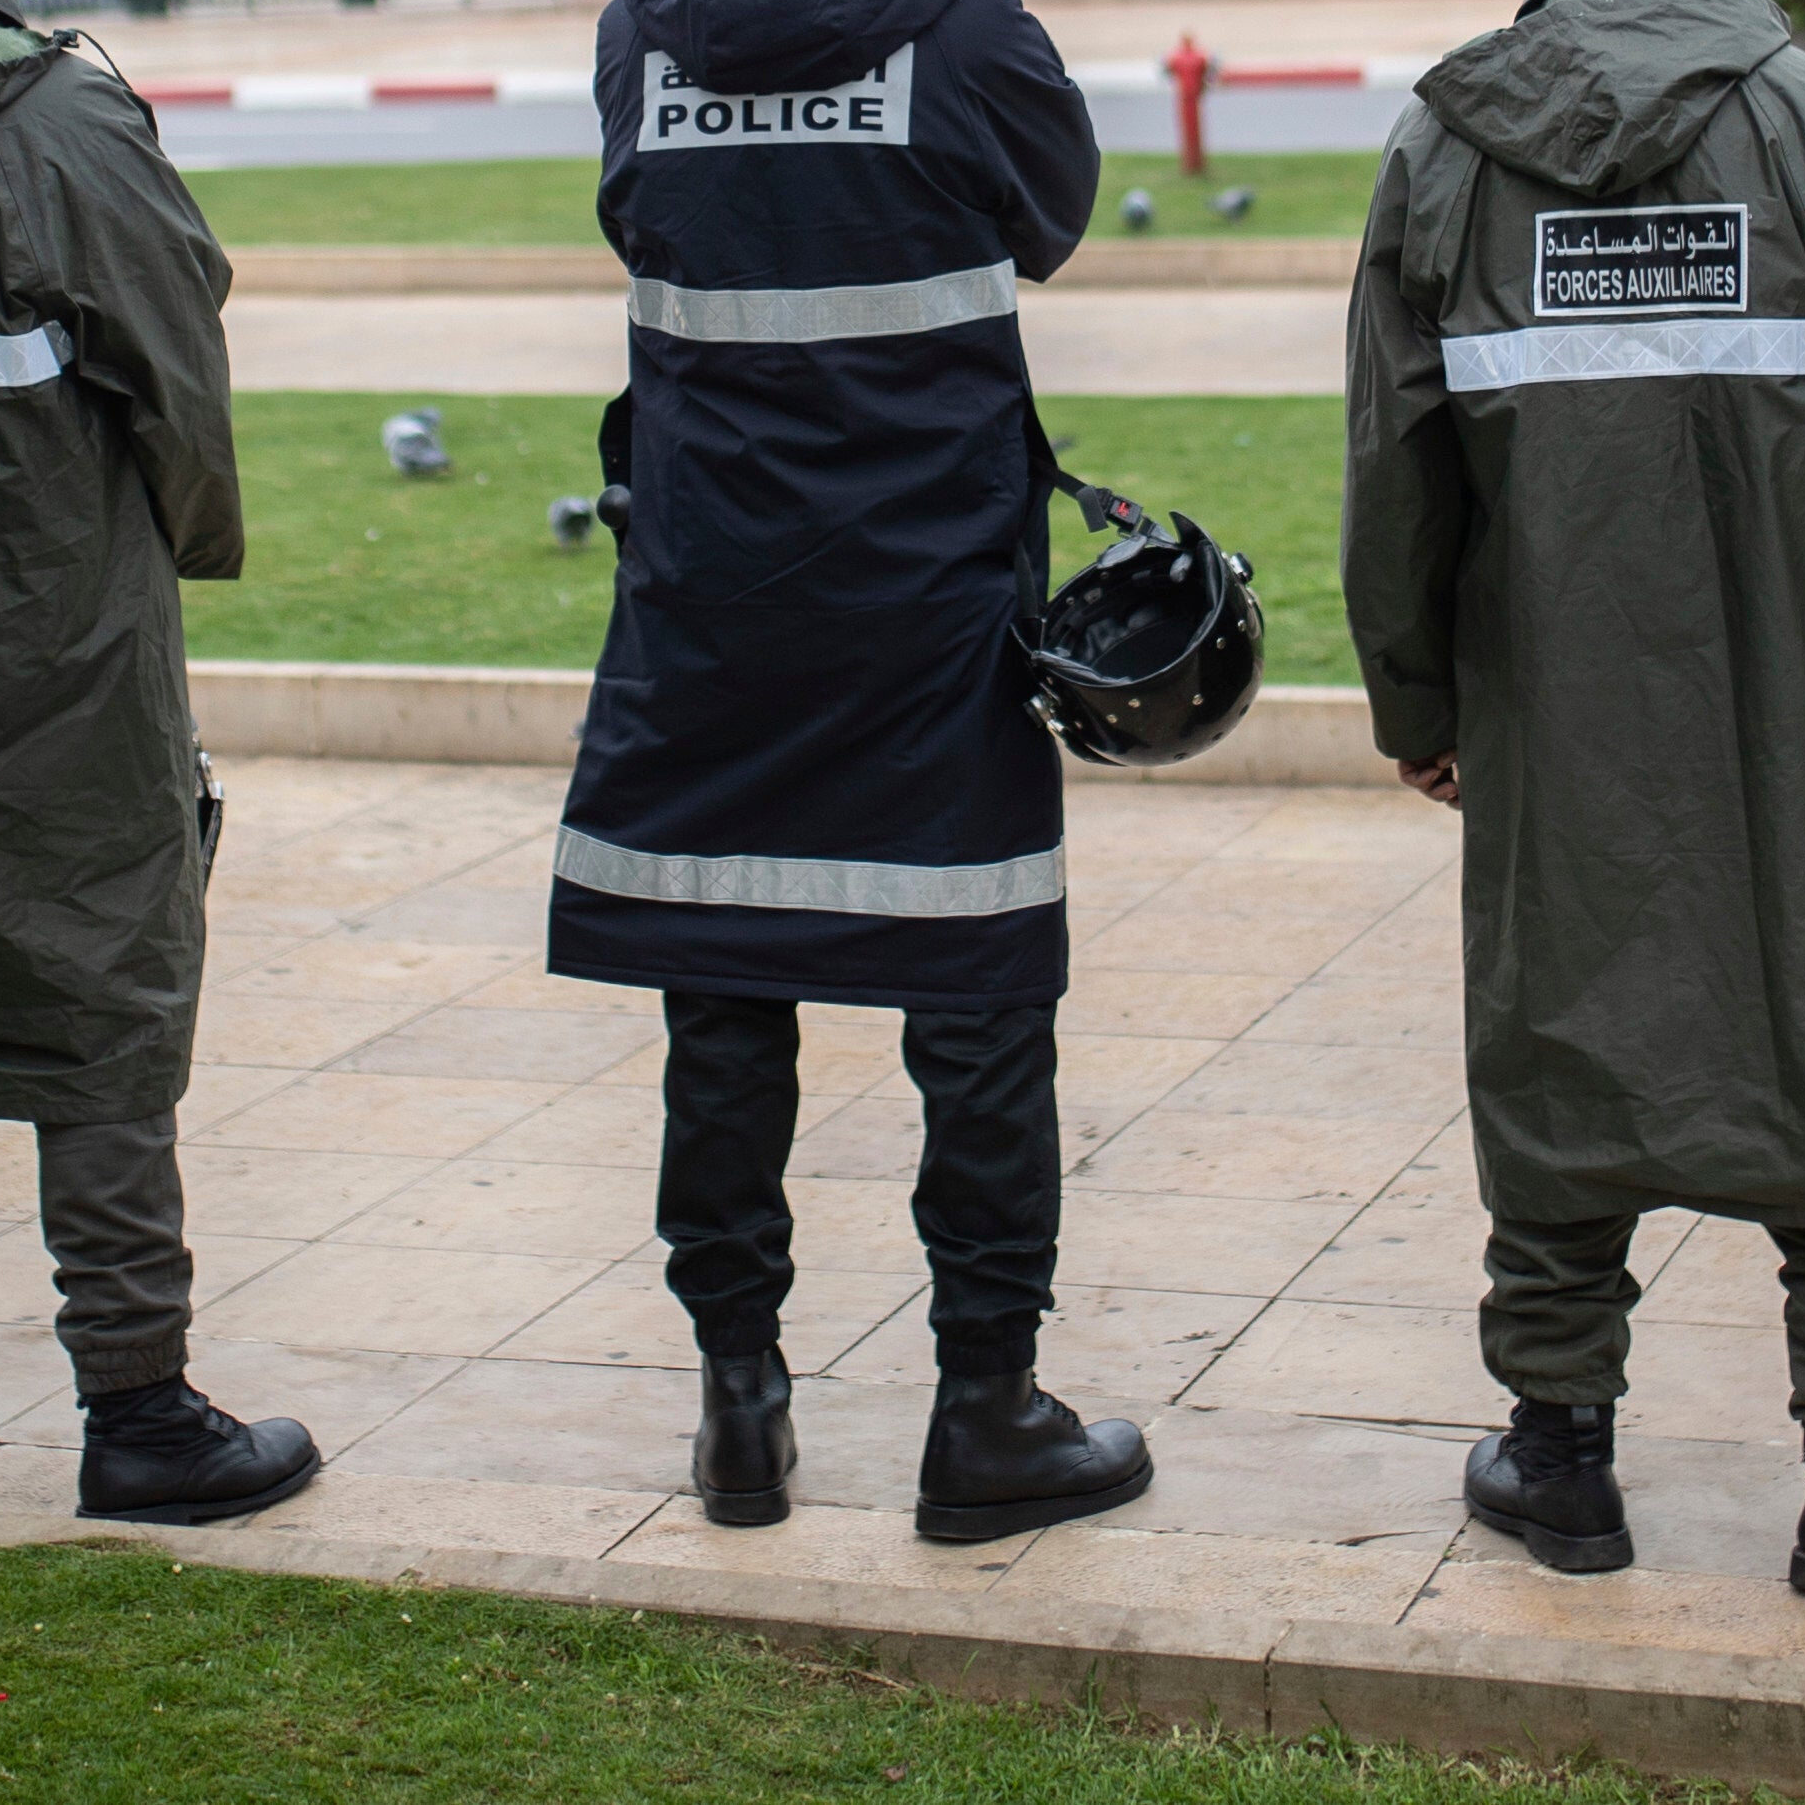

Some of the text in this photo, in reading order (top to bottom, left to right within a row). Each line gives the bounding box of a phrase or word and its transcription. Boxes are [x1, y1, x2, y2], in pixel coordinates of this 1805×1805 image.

[658, 96, 884, 138] POLICE
[1545, 219, 1735, 260] القوات المساعدة
[1545, 265, 1736, 303] FORCES AUXILIAIRES
